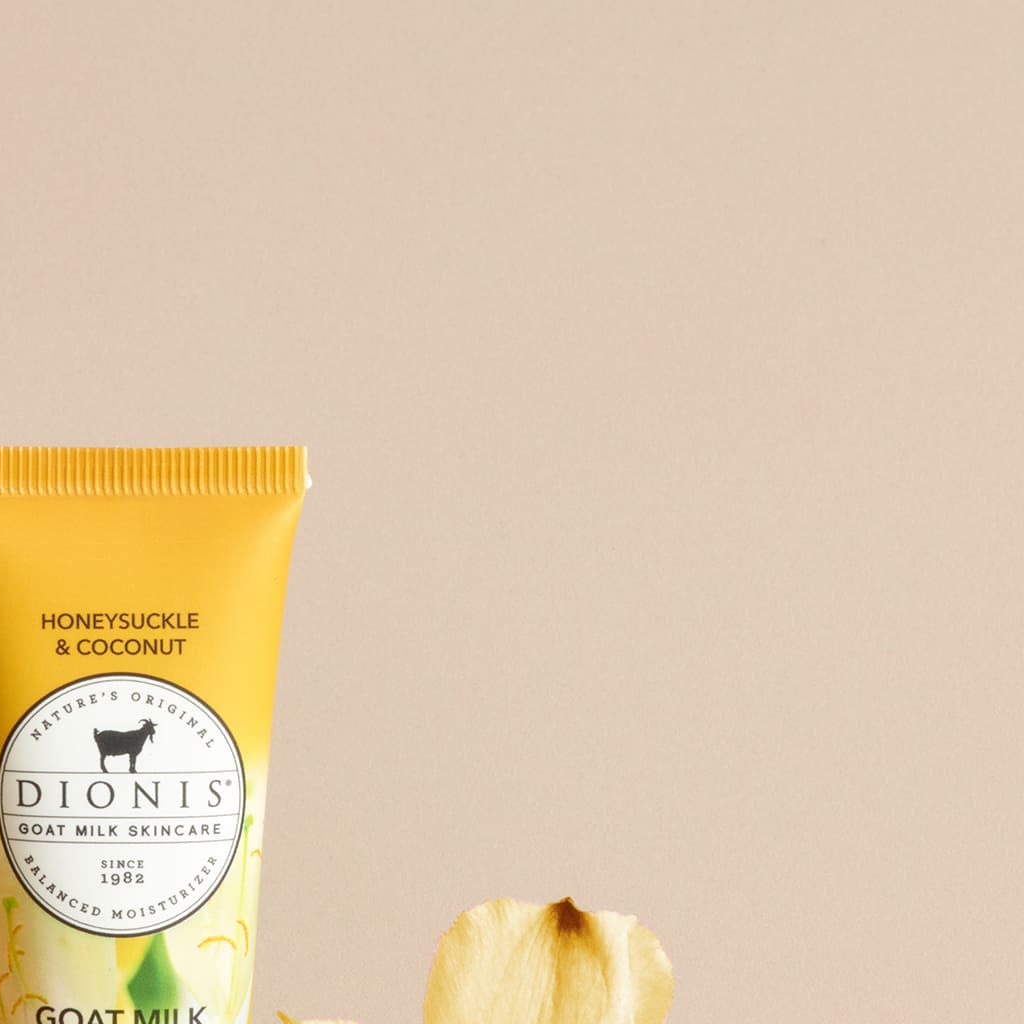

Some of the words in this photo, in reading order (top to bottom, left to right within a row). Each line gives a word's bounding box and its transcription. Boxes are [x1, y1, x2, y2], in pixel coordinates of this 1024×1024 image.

[41, 612, 200, 630] HONEYSUCKLE
[55, 638, 71, 656] &
[76, 638, 187, 656] COCONUT
[30, 690, 119, 742] NATURE'S
[130, 691, 217, 749] ORIGINAL
[18, 823, 65, 837] GOAT
[75, 824, 119, 838] MILK
[128, 823, 222, 837] SKINCARE
[100, 859, 145, 870] SINCE
[24, 855, 102, 919] BALANCED
[111, 856, 217, 920] MOISTURIZER
[100, 871, 146, 886] 1982
